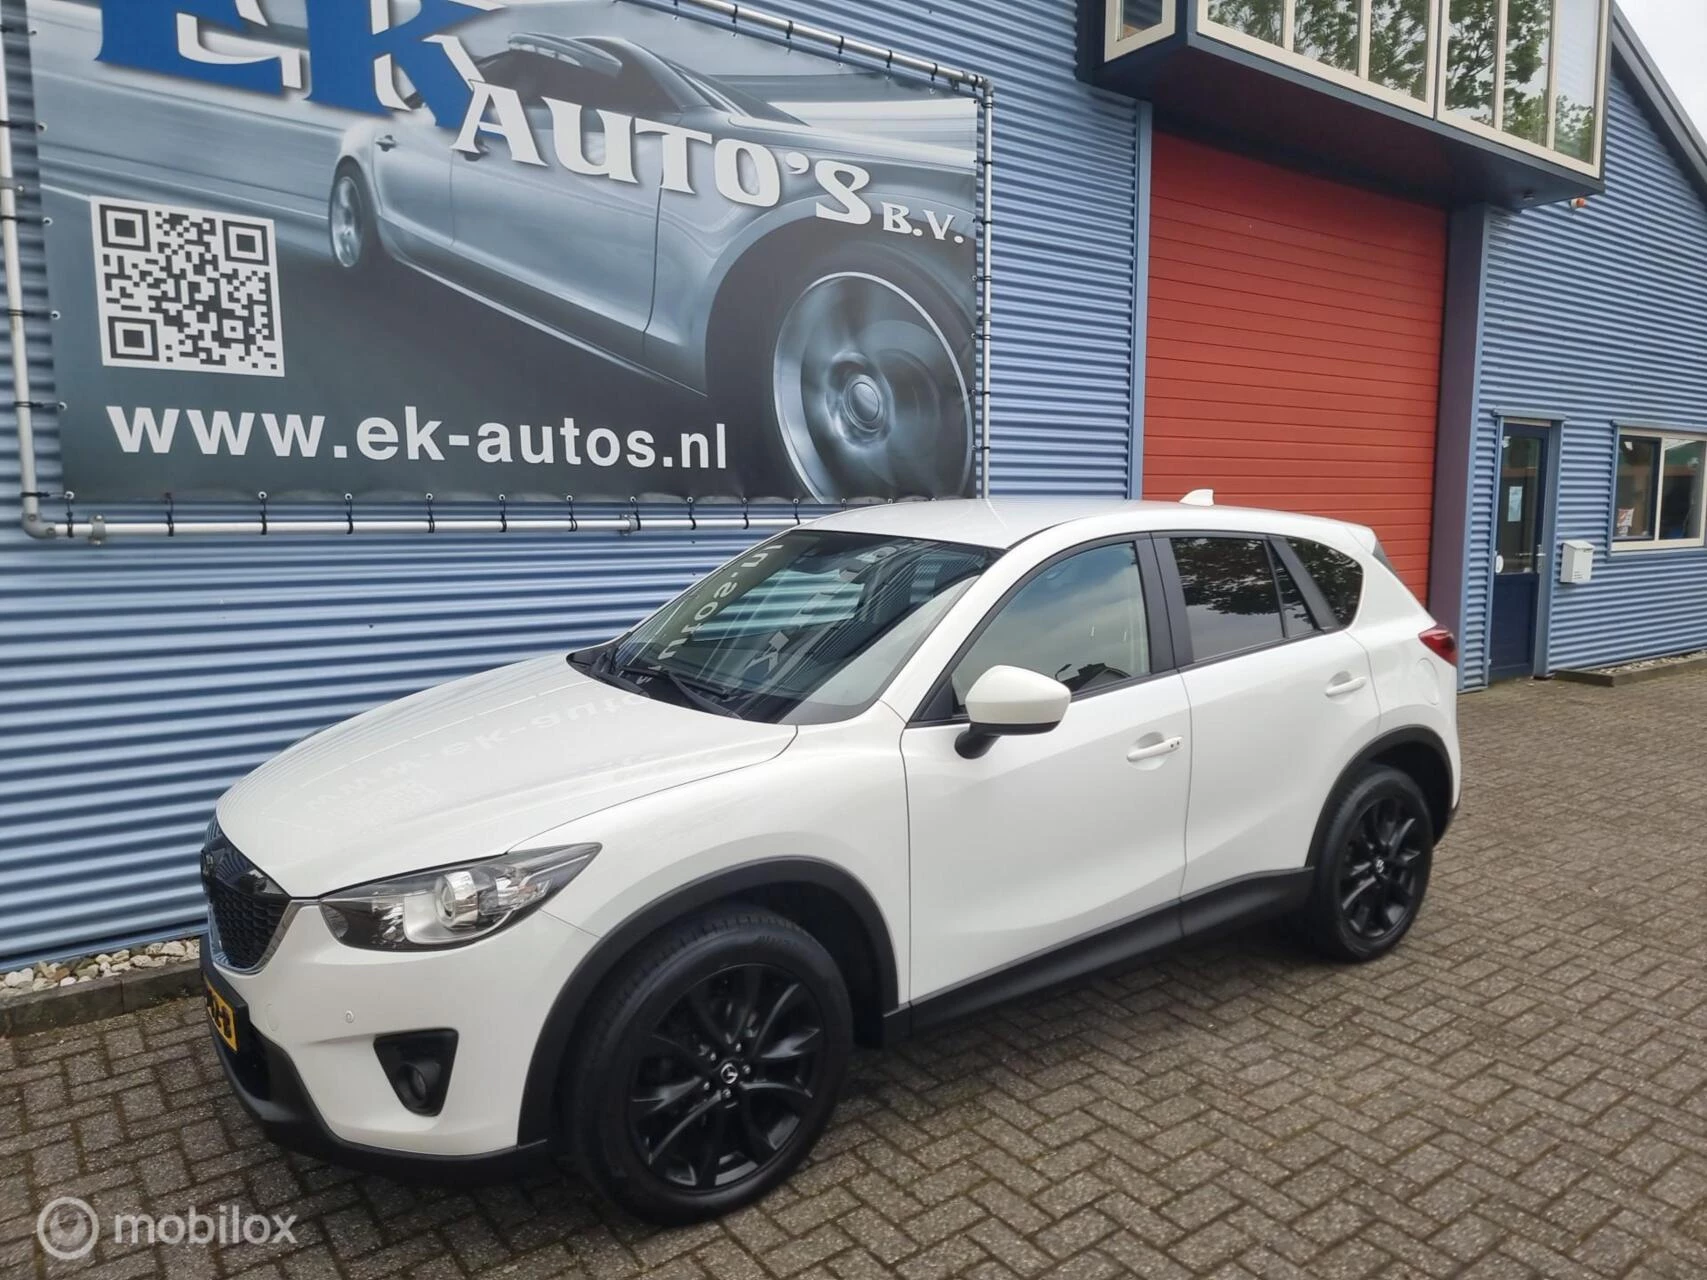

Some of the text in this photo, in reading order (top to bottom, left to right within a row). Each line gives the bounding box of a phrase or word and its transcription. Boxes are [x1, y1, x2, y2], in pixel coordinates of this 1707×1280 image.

[451, 79, 965, 245] AUTO'S B.V.
[106, 405, 727, 469] www.ek-autos.nl
